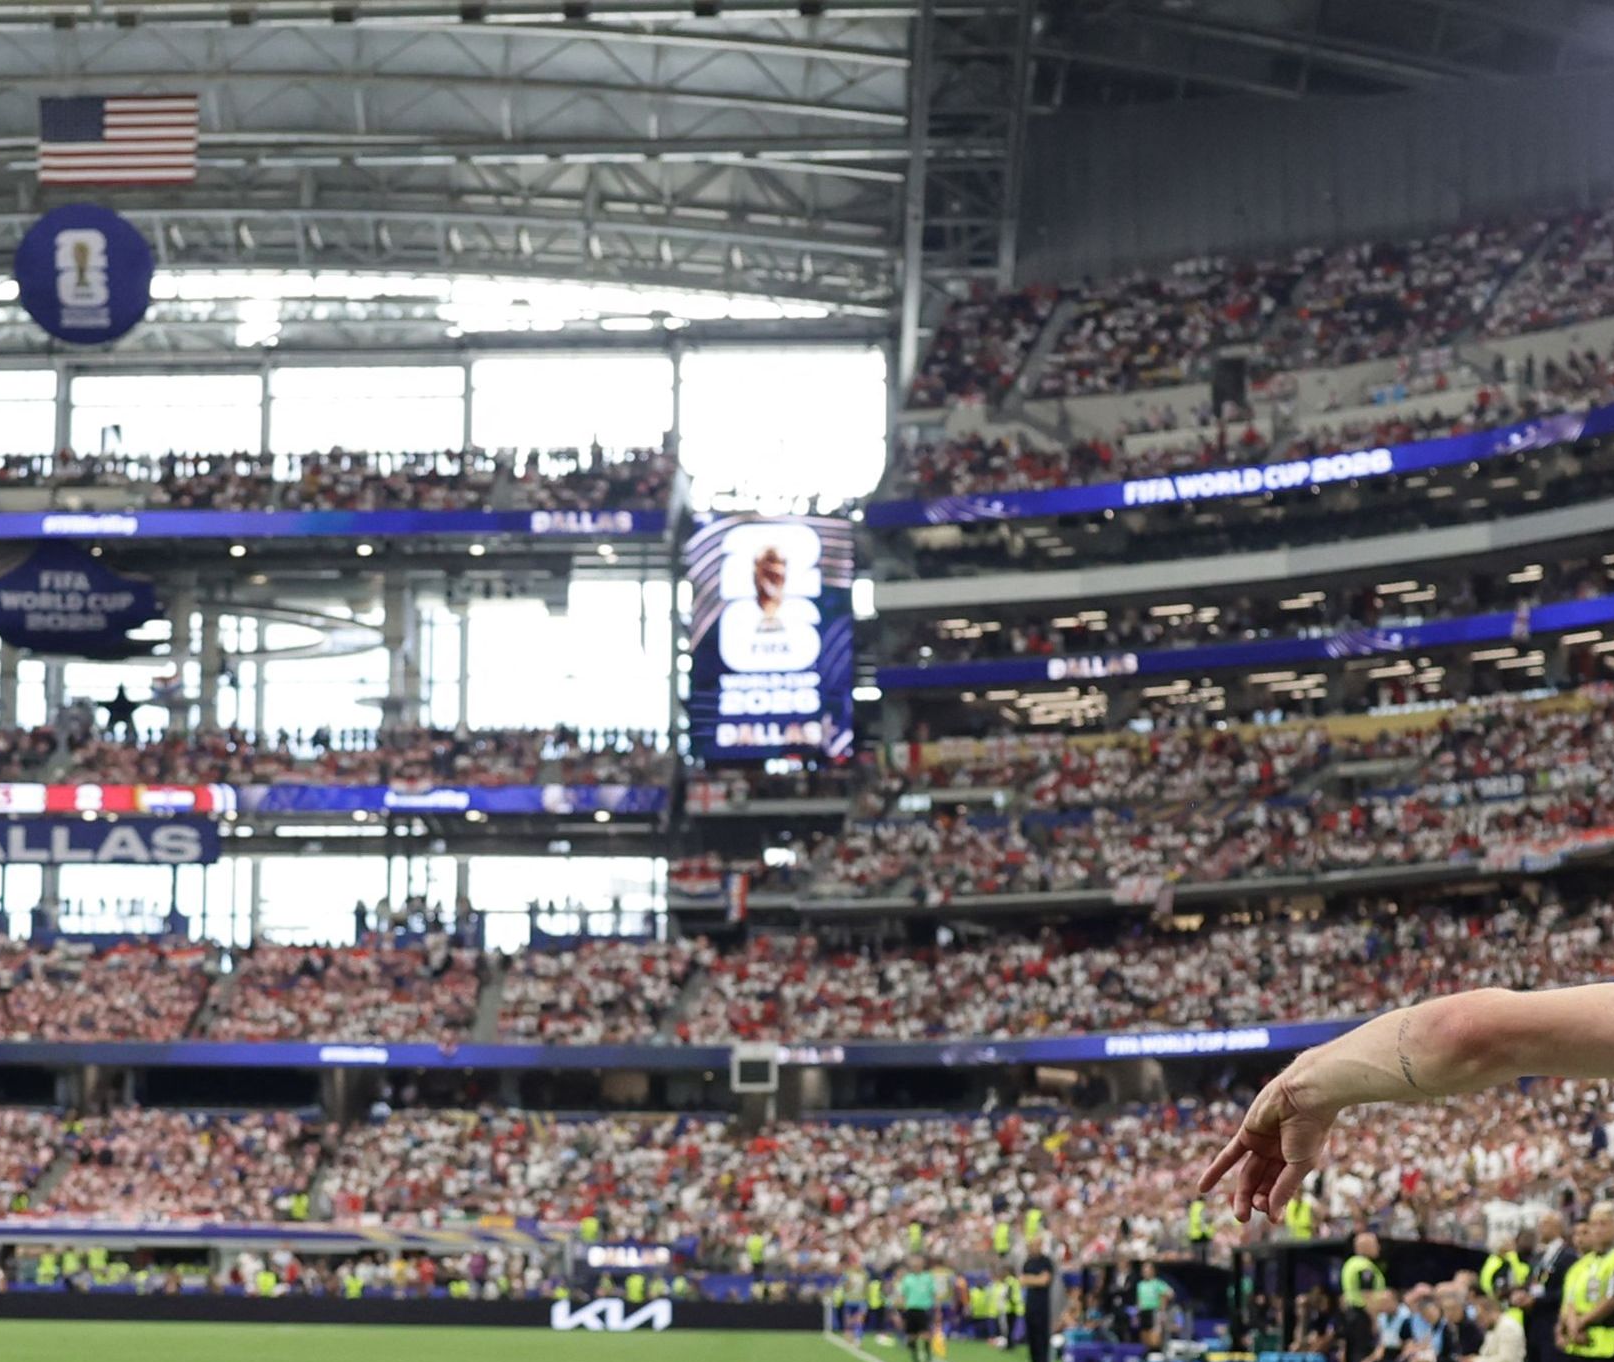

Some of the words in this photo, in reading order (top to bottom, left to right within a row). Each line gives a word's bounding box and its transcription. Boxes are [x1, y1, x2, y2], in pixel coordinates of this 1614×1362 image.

[1123, 477, 1176, 505] FIFA
[1174, 467, 1262, 498] WORLD
[1263, 460, 1310, 490] CUP
[1310, 448, 1392, 482] 2026
[531, 511, 633, 534] DALLAS
[39, 569, 91, 590] FIFA
[86, 591, 134, 612] CUP
[1048, 654, 1138, 680] DALLAS
[718, 687, 822, 715] 2026
[715, 722, 823, 747] DALLAS
[587, 1245, 671, 1269] DALLAS
